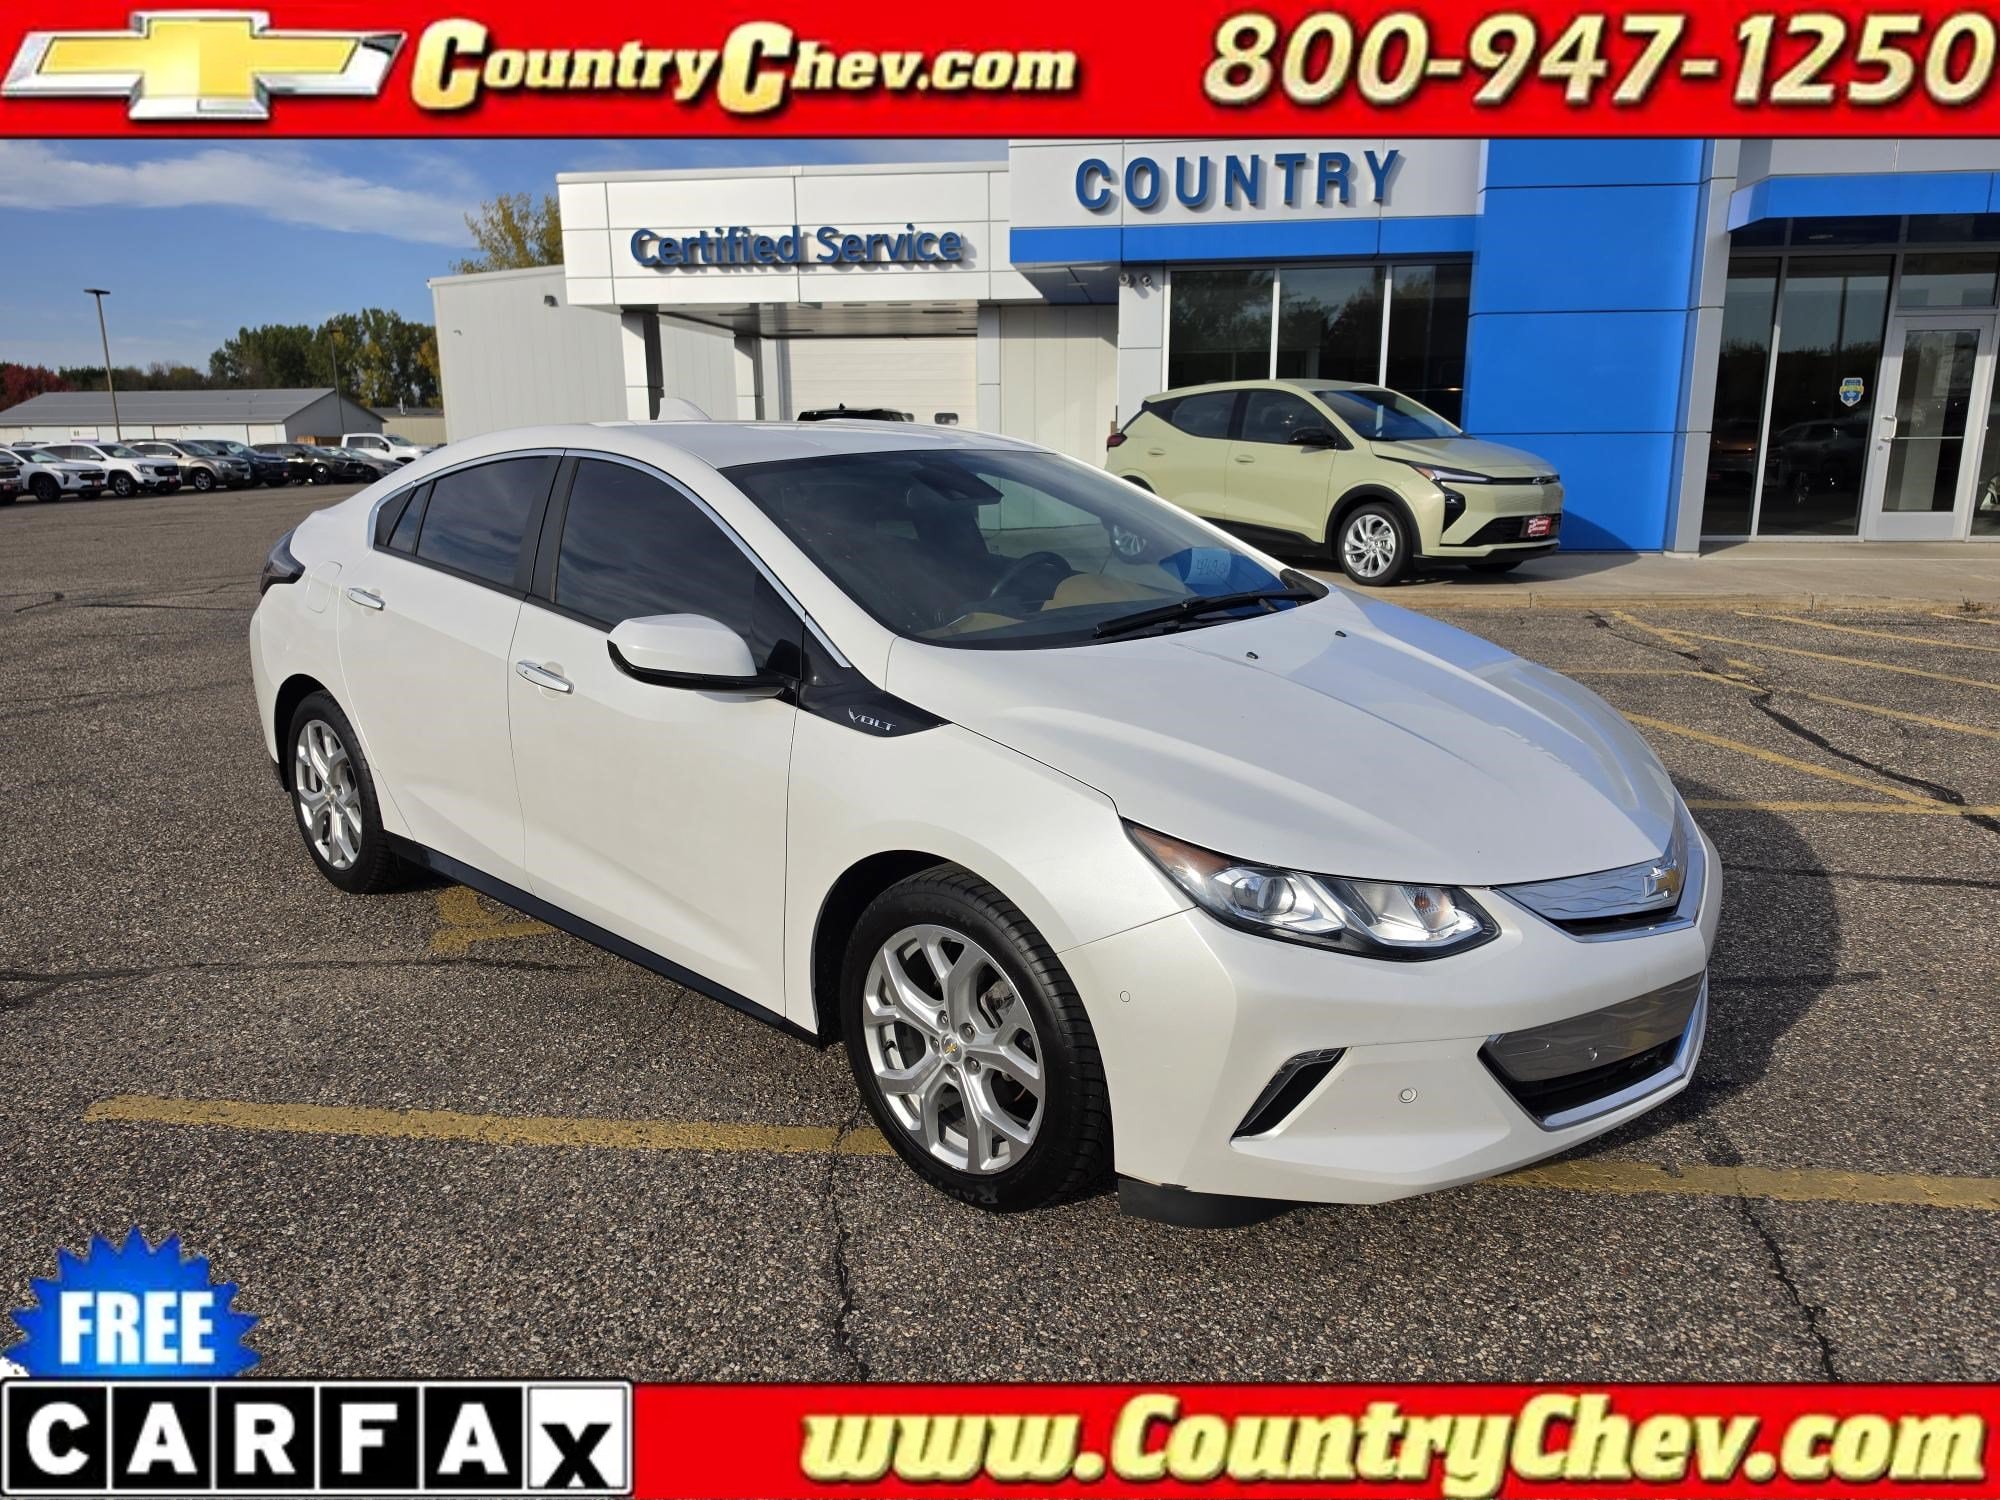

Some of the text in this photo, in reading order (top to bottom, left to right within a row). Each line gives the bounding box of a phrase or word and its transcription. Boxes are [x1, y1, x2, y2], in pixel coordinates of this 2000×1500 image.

[1076, 149, 1400, 211] COUNTRY
[630, 223, 964, 268] Certified Service
[848, 707, 896, 731] VOLT
